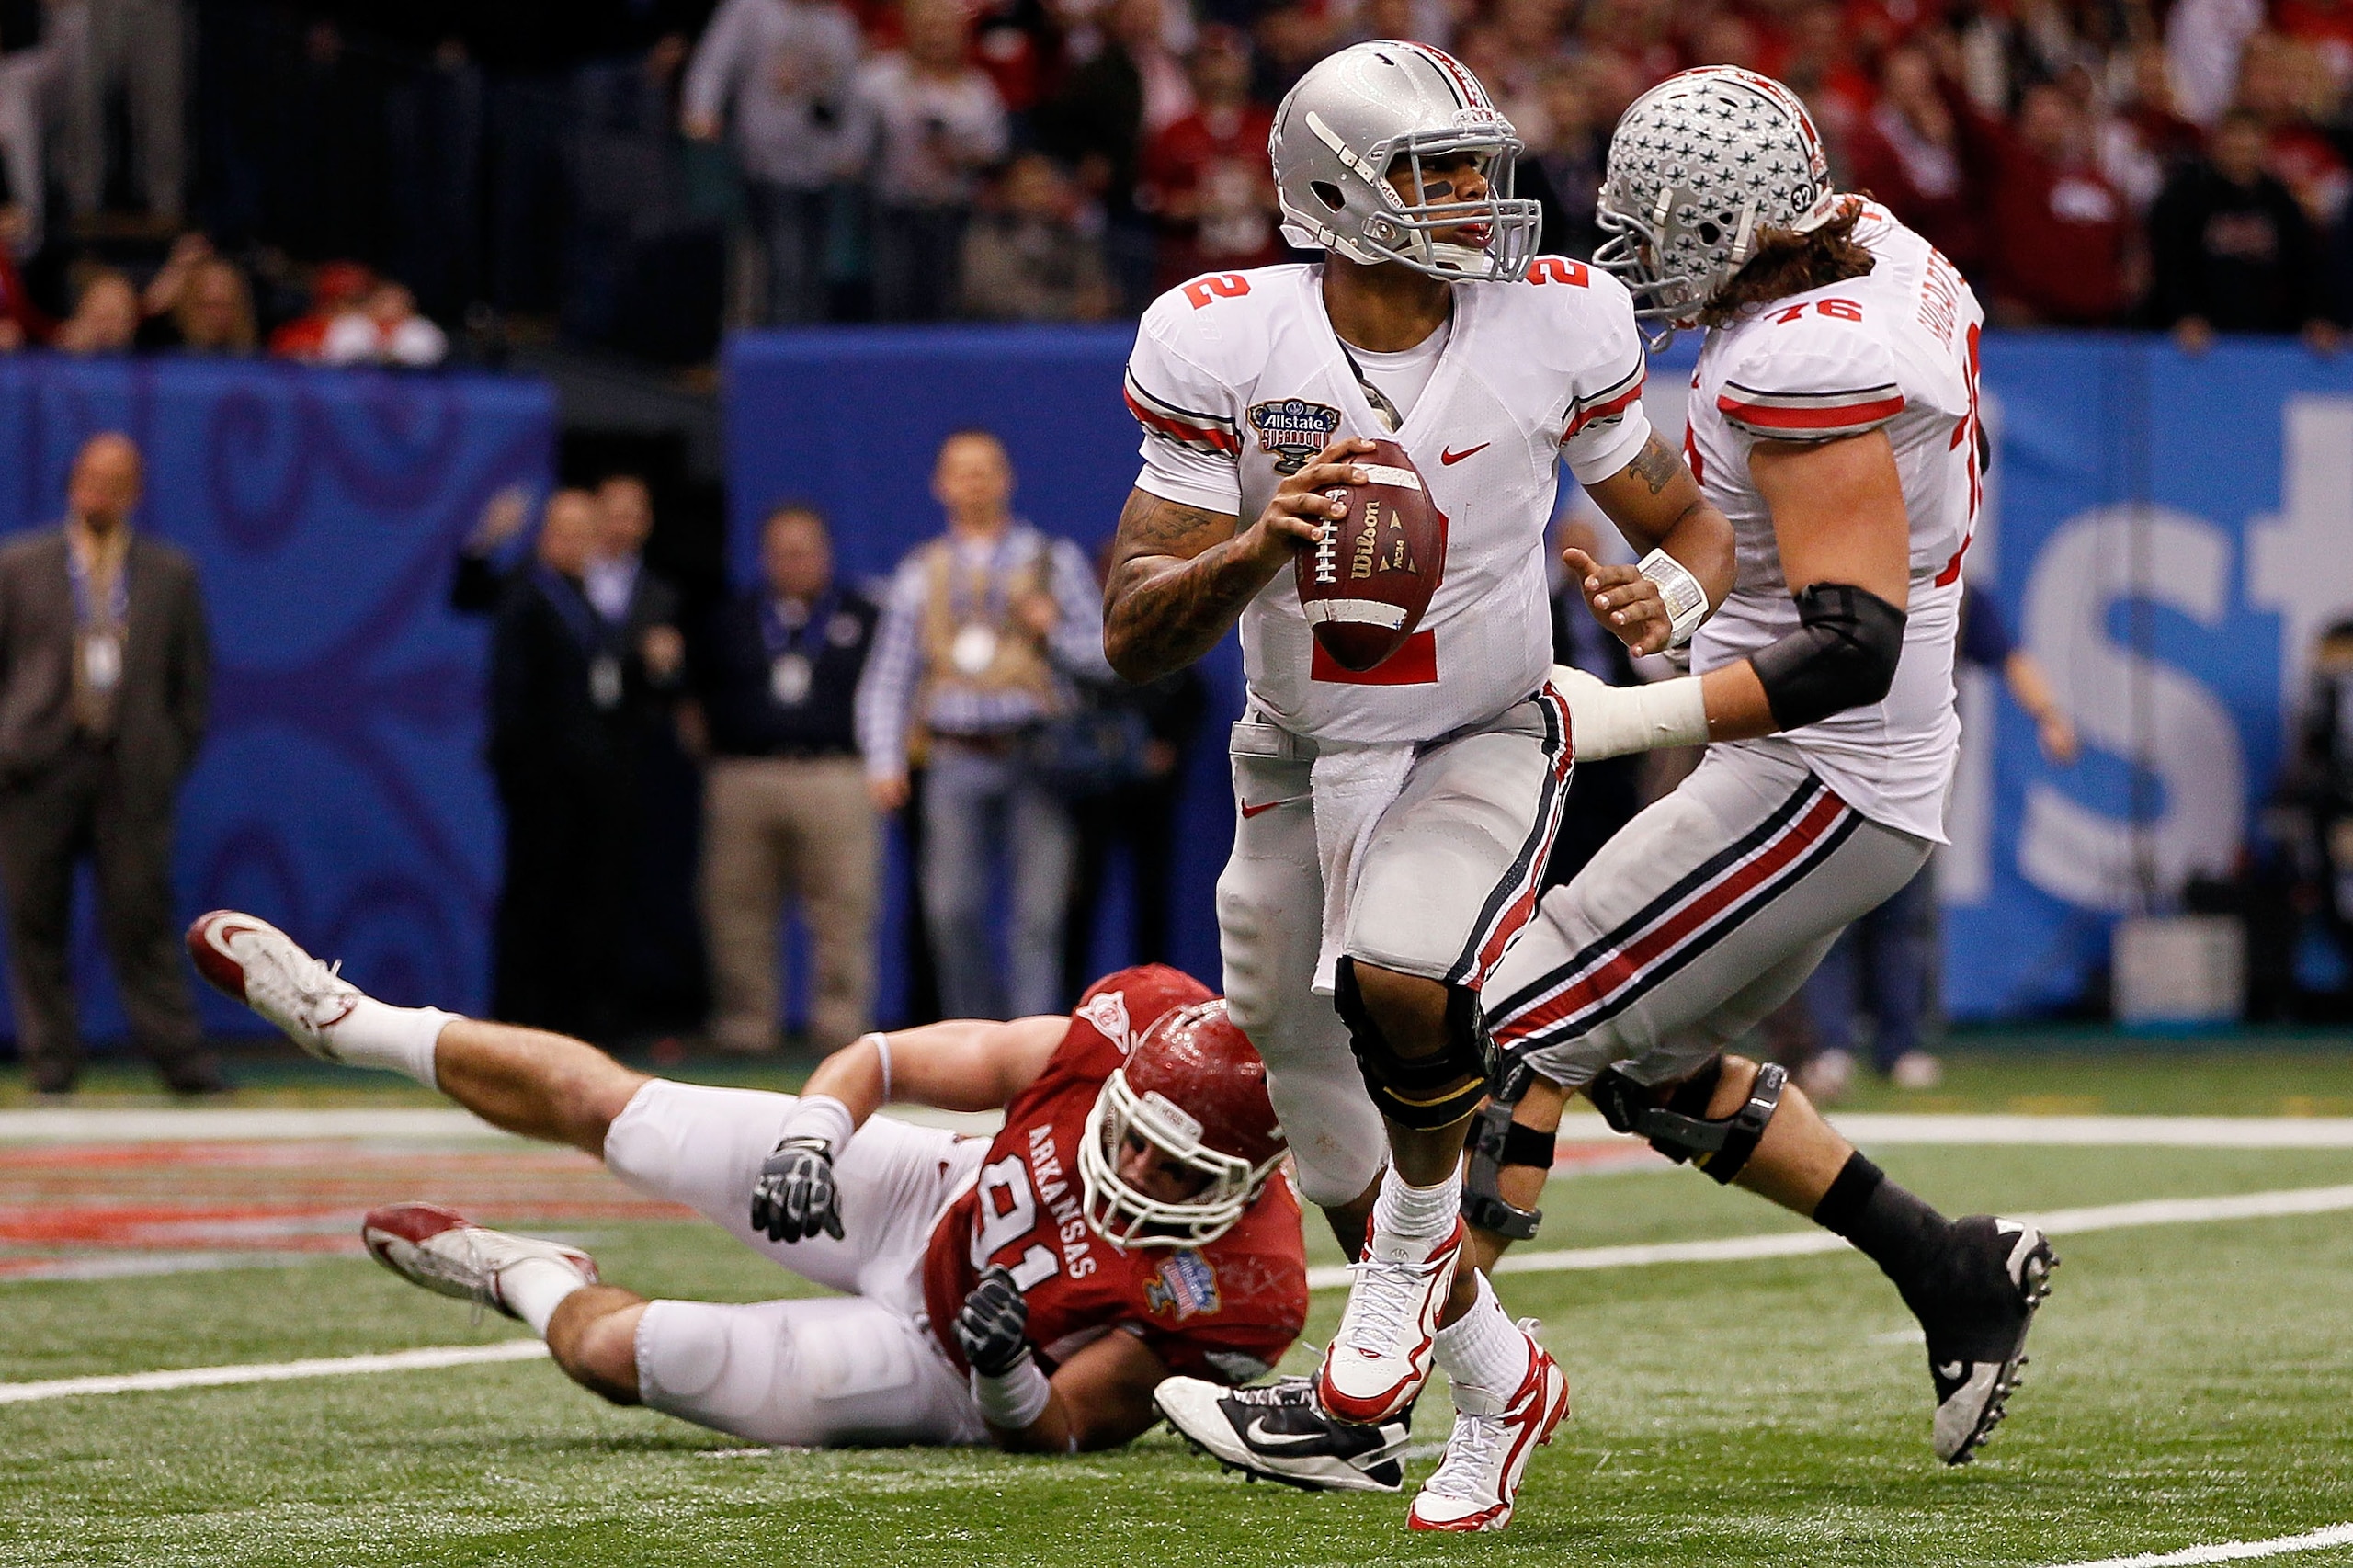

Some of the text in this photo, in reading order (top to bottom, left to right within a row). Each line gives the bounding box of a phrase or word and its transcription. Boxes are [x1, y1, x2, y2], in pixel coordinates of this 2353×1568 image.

[1792, 187, 1812, 211] 32
[1526, 258, 1589, 289] 2
[1181, 274, 1251, 310] 2
[1764, 298, 1862, 324] 76
[1350, 500, 1381, 579] Wilson
[1029, 1123, 1097, 1279] ARKANSAS
[970, 1153, 1060, 1292] 91
